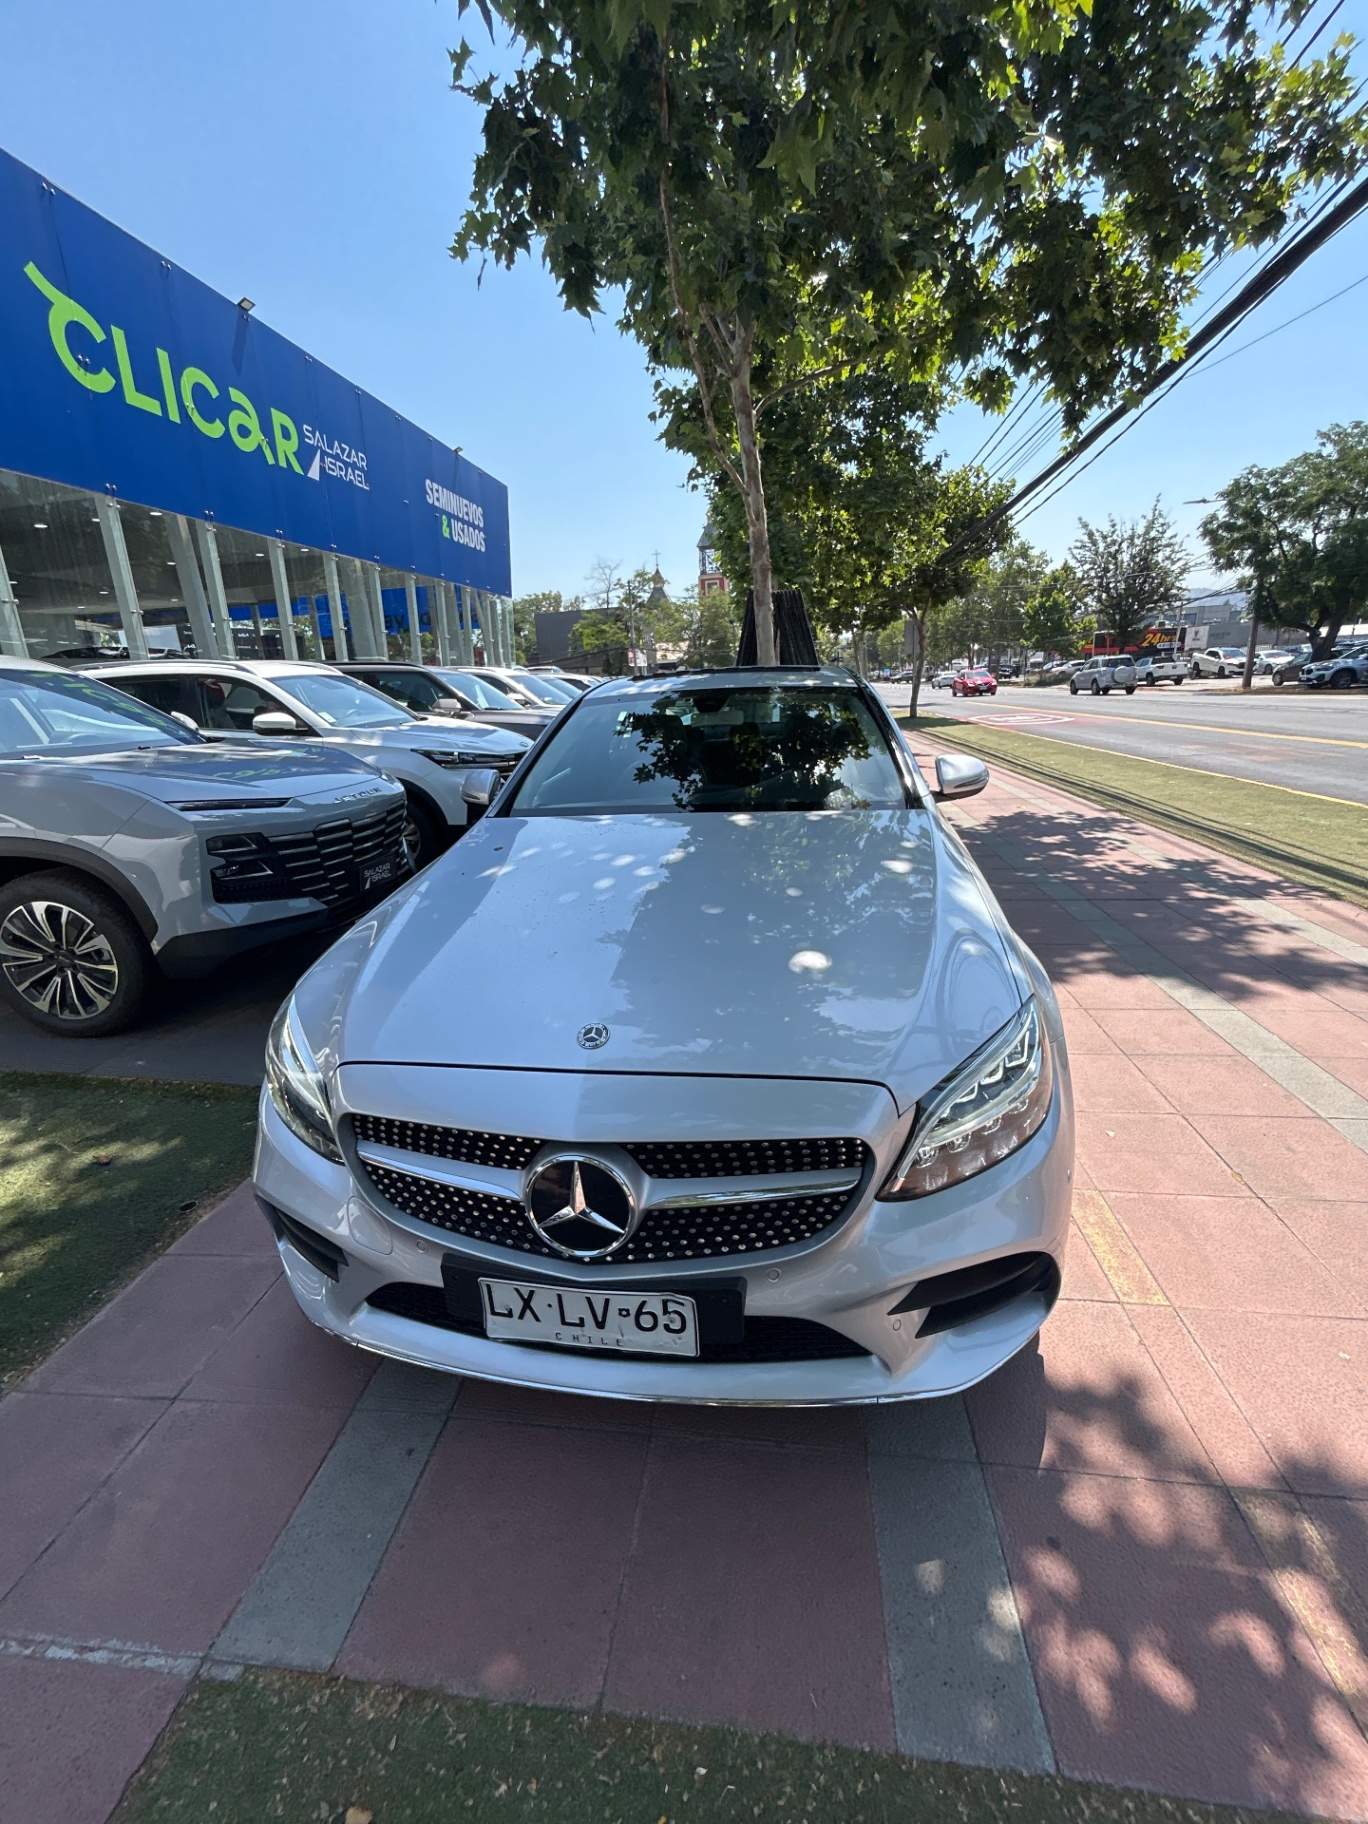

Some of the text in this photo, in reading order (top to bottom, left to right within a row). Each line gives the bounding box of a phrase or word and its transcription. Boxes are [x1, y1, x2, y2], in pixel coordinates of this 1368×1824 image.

[303, 424, 368, 471] SALAZAR
[324, 455, 370, 491] ISRAEL
[425, 478, 484, 528] SEMINUEVOS
[442, 514, 486, 553] & USADOS
[555, 1332, 624, 1347] CHILE
